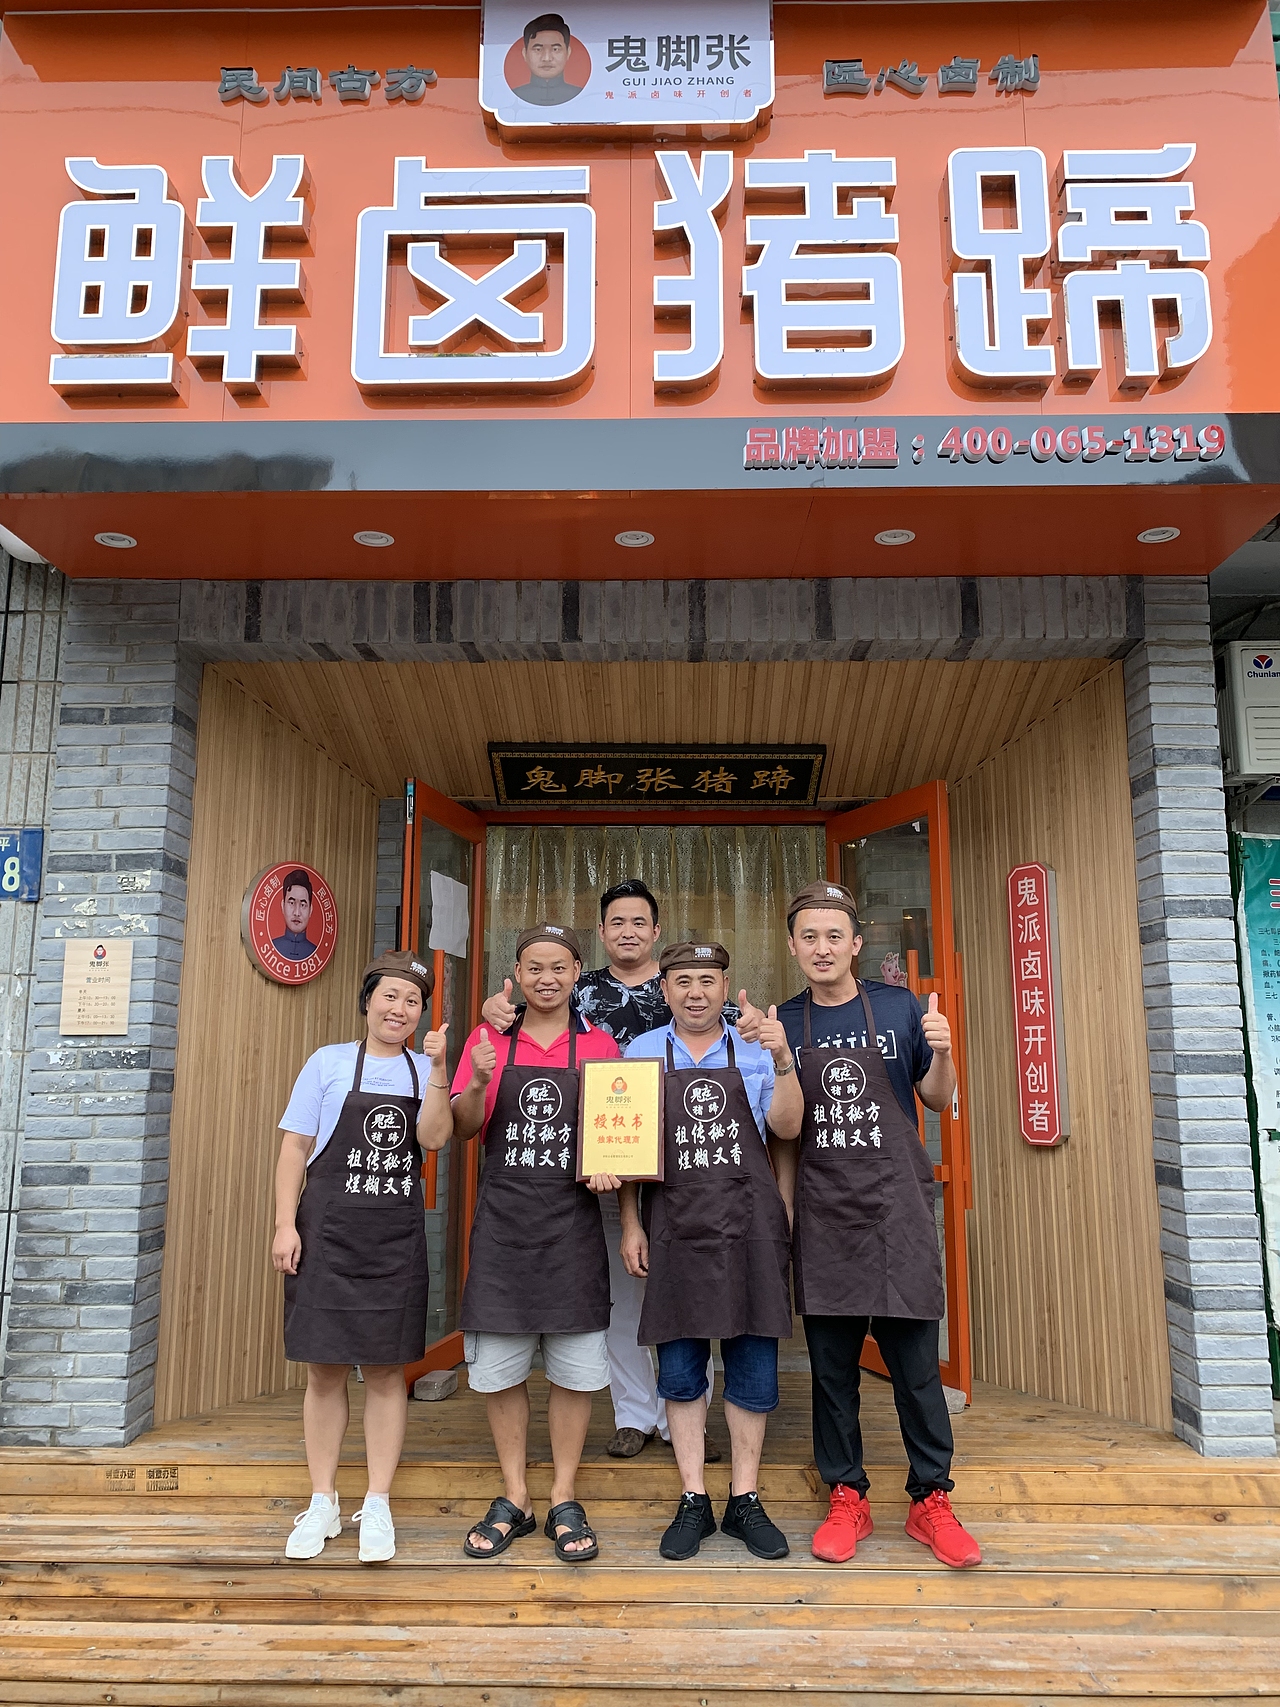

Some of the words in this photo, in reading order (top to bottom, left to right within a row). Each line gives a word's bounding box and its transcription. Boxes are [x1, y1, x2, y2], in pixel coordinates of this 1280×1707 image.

[605, 34, 752, 73] 鬼脚张
[218, 65, 438, 102] 民间古方
[622, 77, 646, 86] GUI
[651, 77, 683, 86] JIAO
[687, 76, 735, 86] ZHANG
[823, 54, 1041, 94] 匠心卤制
[605, 89, 752, 100] 鬼派卤味开创者
[48, 144, 1213, 388] 鲜卤猪蹄
[520, 764, 796, 796] 鬼脚张猪蹄
[317, 886, 335, 935] 民间古方
[294, 953, 323, 978] 1981
[1016, 876, 1051, 1132] 鬼派卤味开创者
[830, 1083, 859, 1097] 猪蹄
[527, 1103, 555, 1117] 猪蹄
[593, 1112, 643, 1131] 授权书
[692, 1102, 720, 1116] 猪蹄
[813, 1101, 881, 1126] 祖传秘方
[370, 1131, 400, 1145] 猪蹄
[505, 1121, 573, 1145] 祖传秘方
[596, 1135, 641, 1145] 独家代理商
[674, 1118, 741, 1147] 祖传秘方
[346, 1147, 414, 1173] 祖传秘方
